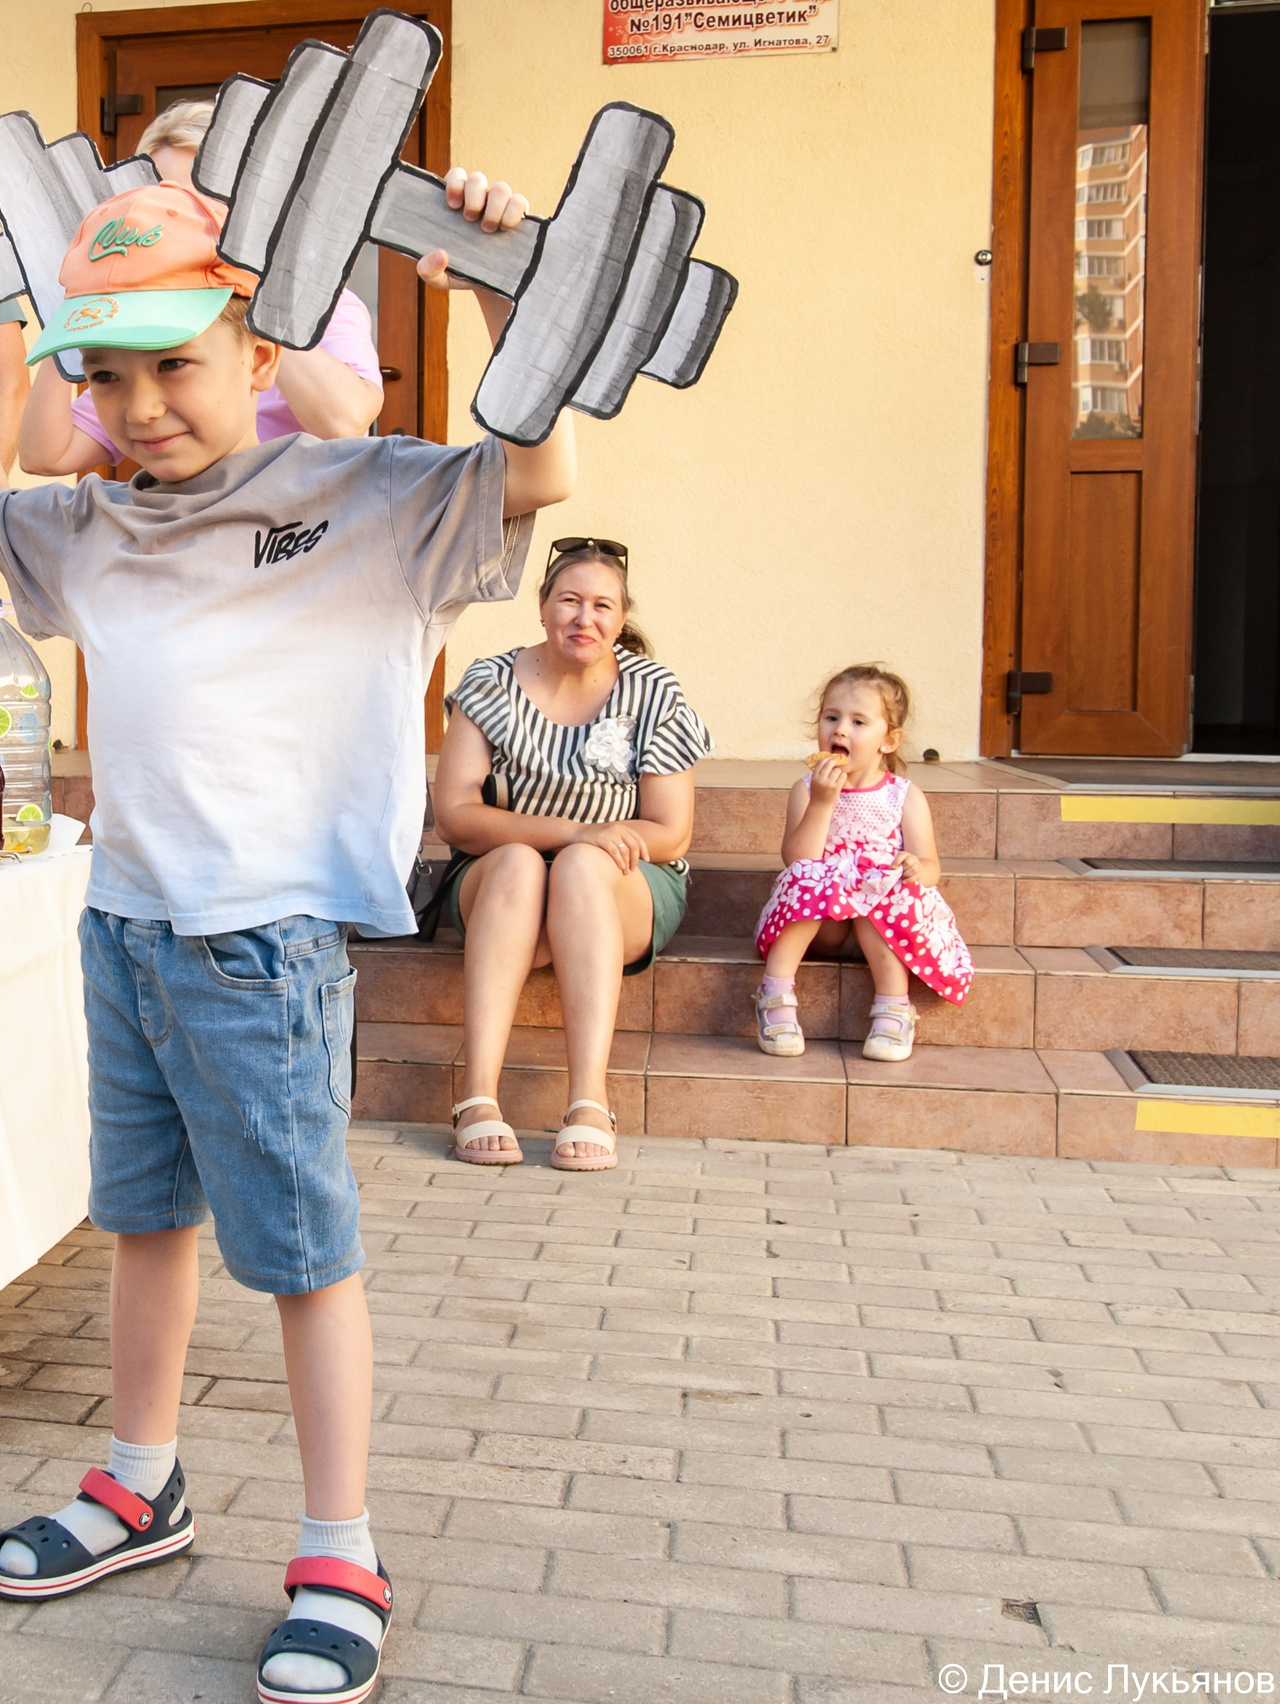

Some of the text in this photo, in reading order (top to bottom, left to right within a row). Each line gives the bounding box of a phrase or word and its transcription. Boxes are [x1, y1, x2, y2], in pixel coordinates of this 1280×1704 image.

[609, 45, 648, 56] 350061
[732, 41, 749, 51] ул.
[754, 37, 812, 47] Игнатова,
[815, 35, 830, 44] 27
[254, 520, 329, 568] VIBES
